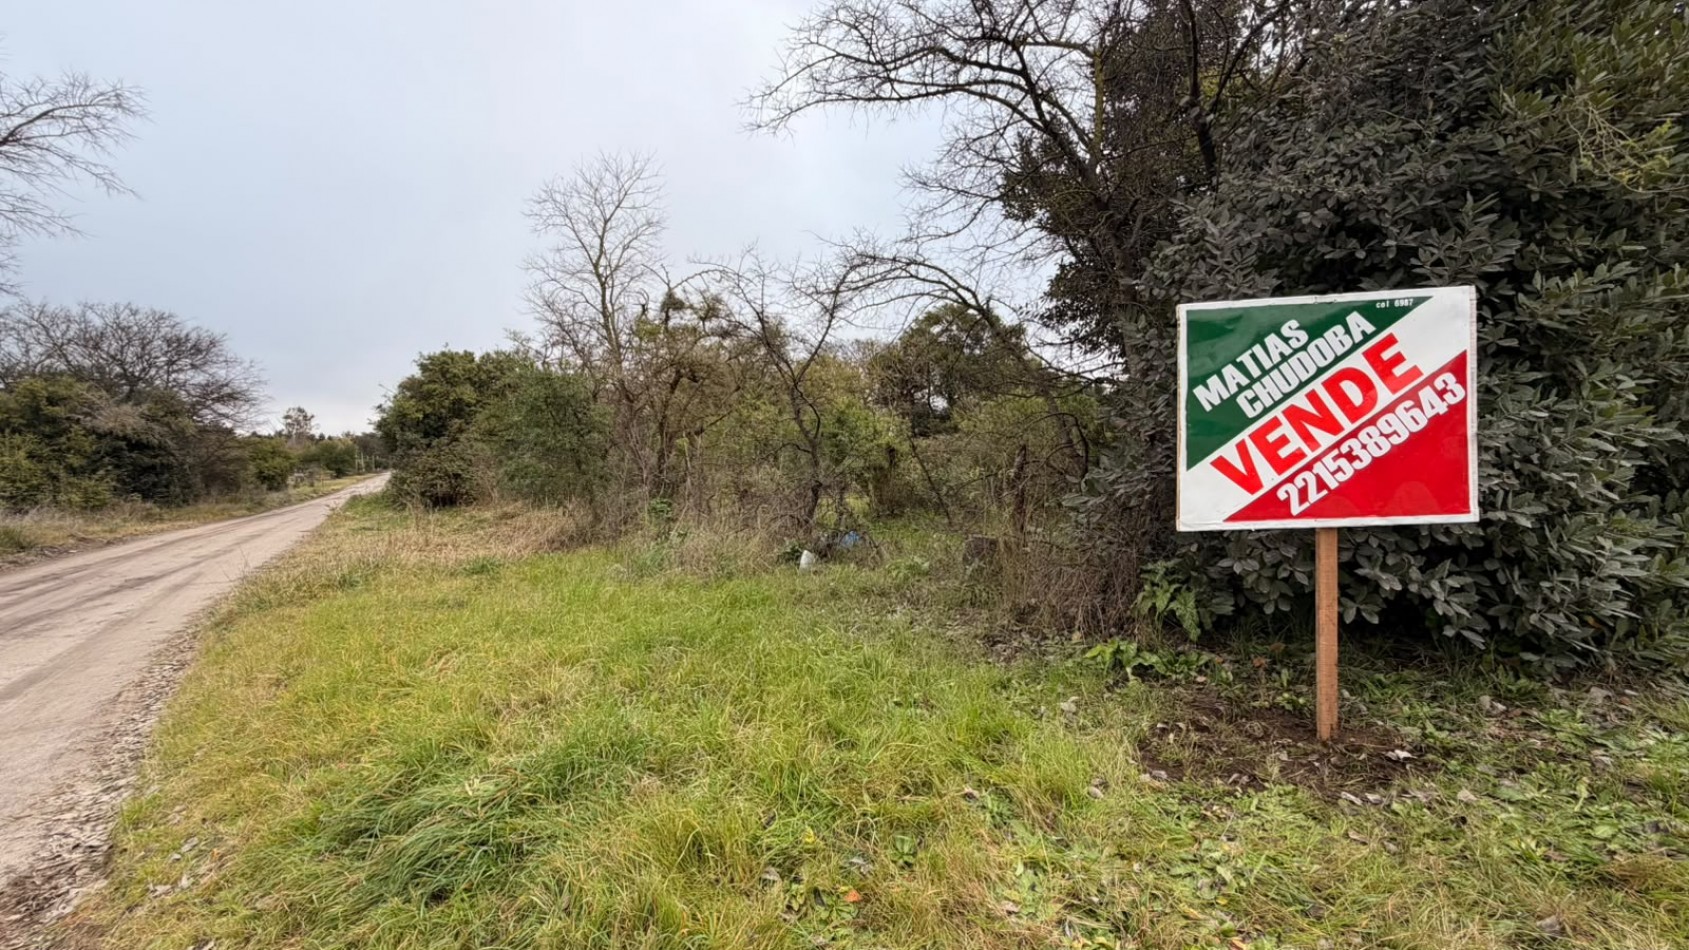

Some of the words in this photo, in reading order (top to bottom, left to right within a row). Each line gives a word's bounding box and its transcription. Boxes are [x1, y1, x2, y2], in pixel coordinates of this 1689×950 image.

[1193, 319, 1309, 412] MATIAS
[1210, 332, 1424, 495] VENDE
[1236, 310, 1377, 418] CHUDOBA
[1276, 371, 1466, 516] 2215389643
